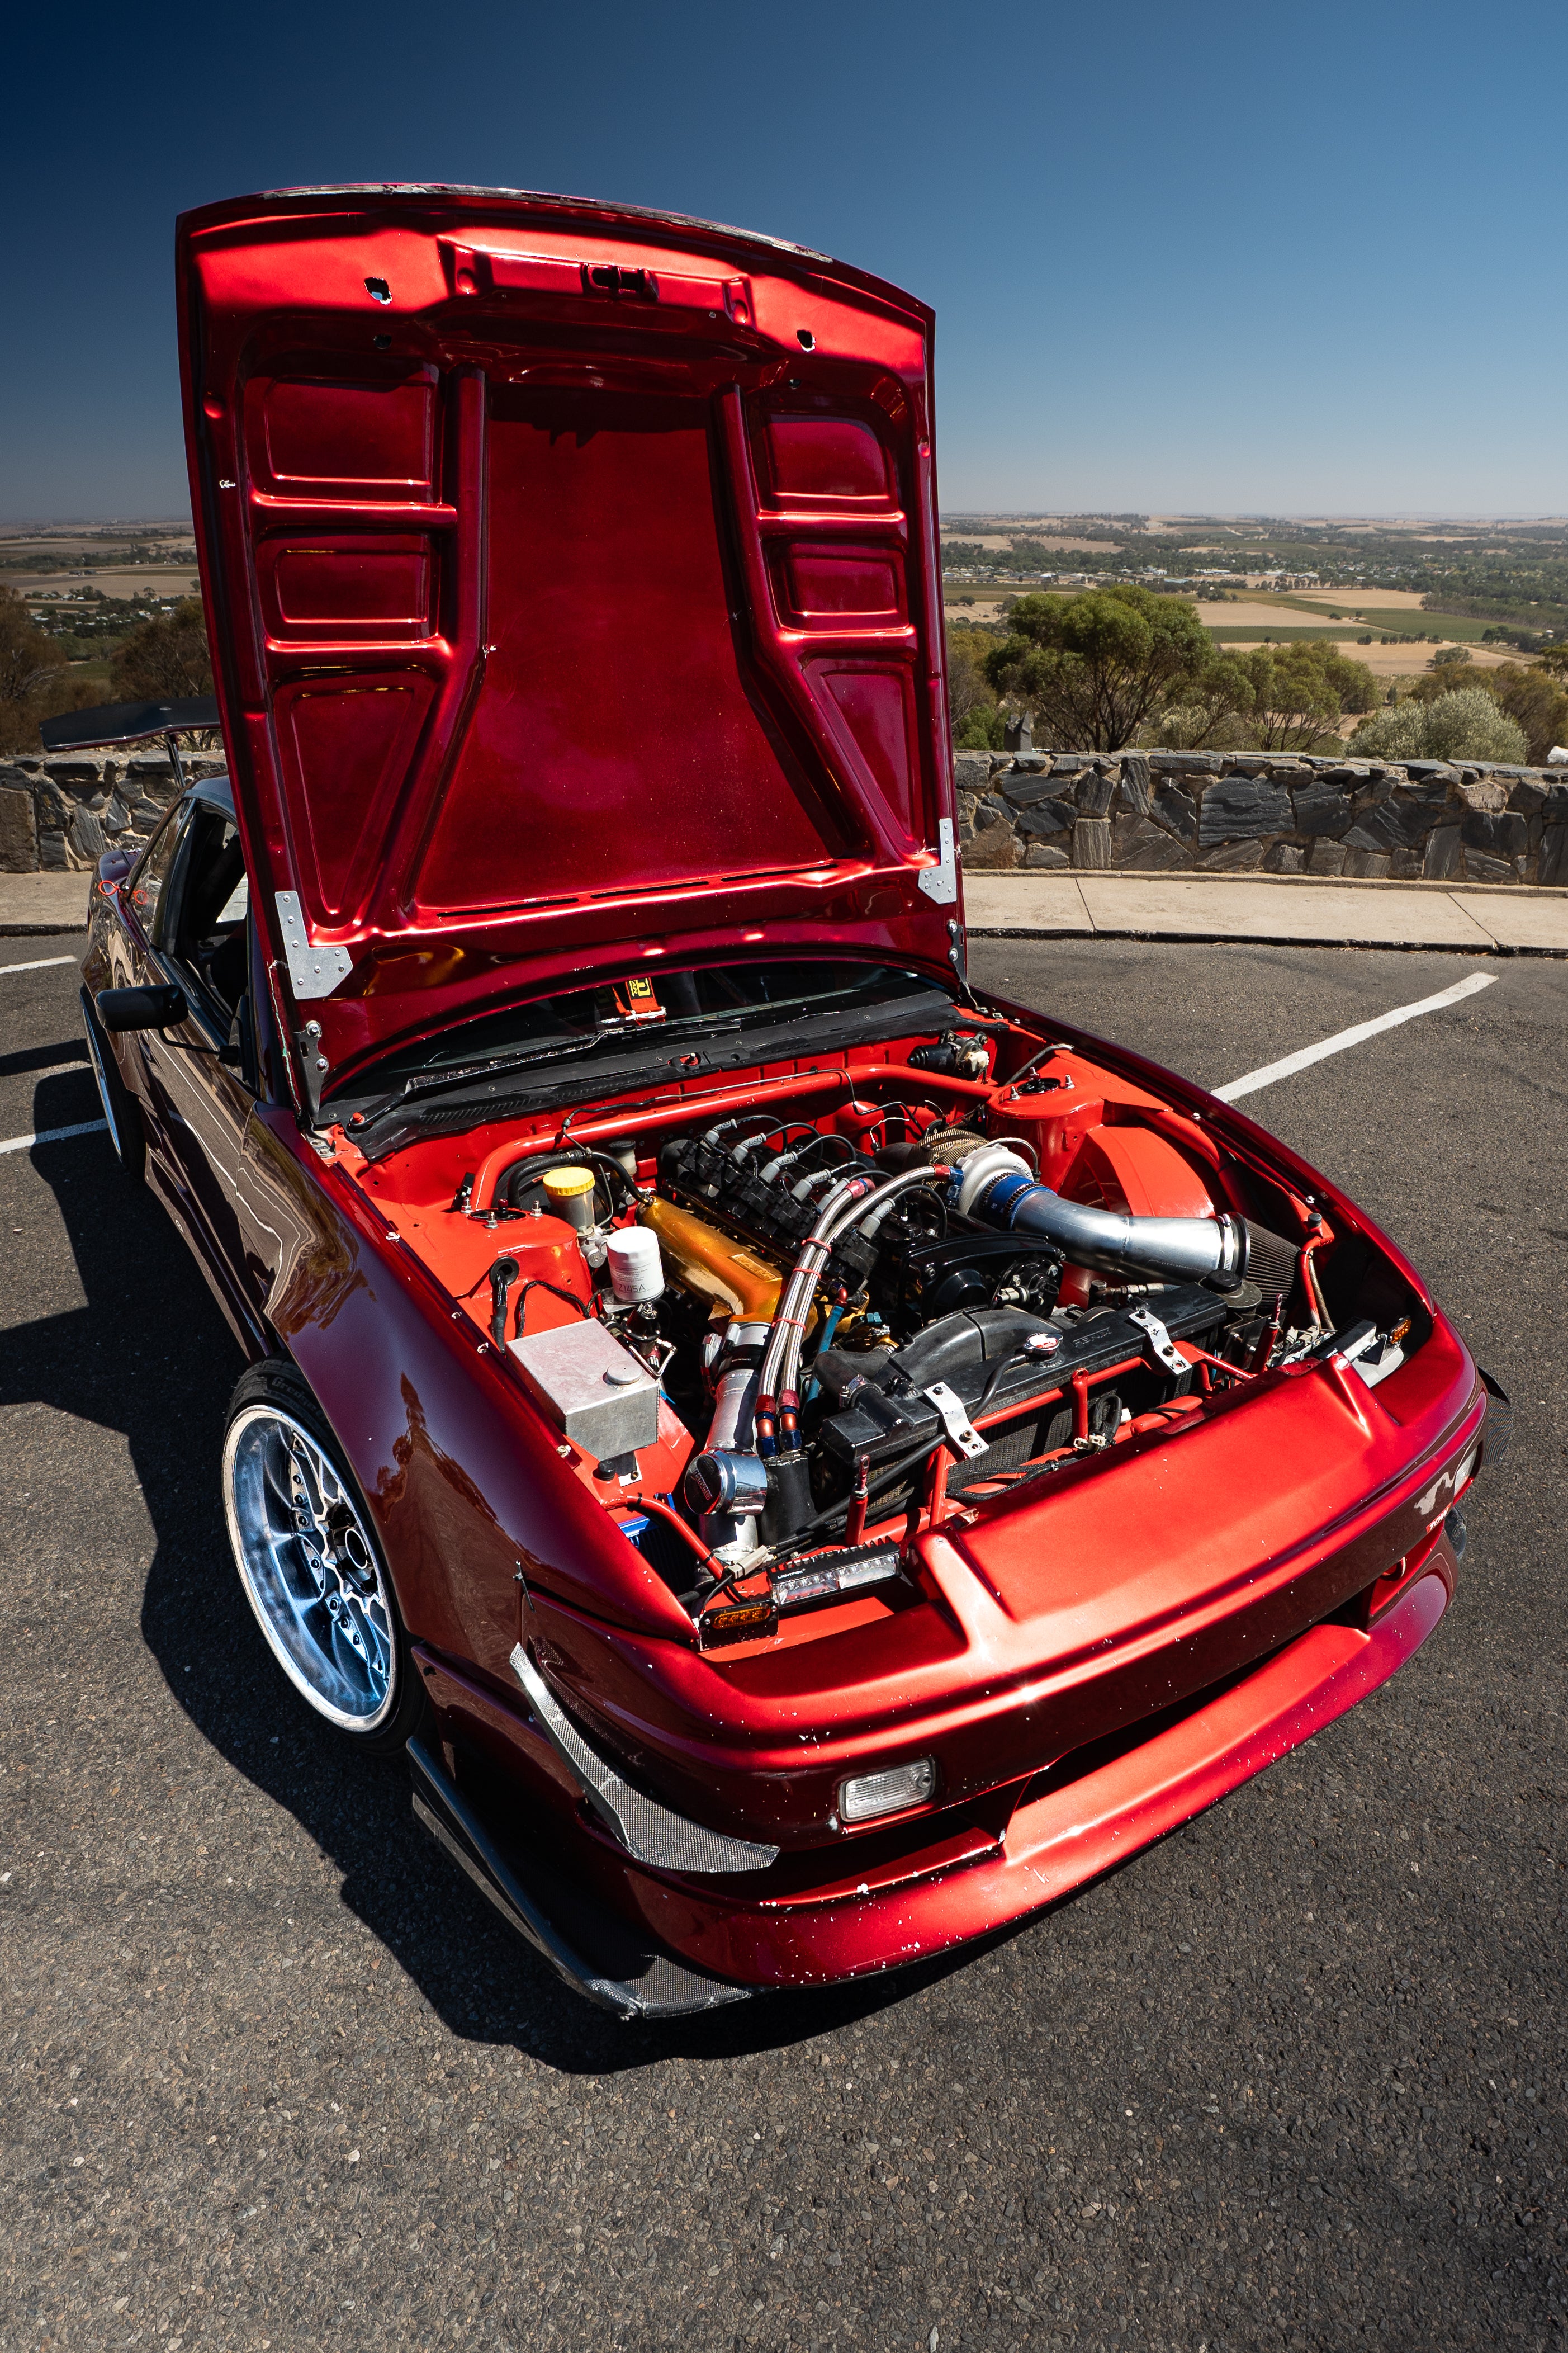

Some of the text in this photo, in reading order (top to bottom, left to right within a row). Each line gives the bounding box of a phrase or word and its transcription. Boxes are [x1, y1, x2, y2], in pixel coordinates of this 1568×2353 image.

[617, 1283, 646, 1292] Z145A
[1073, 1326, 1112, 1348] FENIX
[1429, 1507, 1449, 1530] TOW
